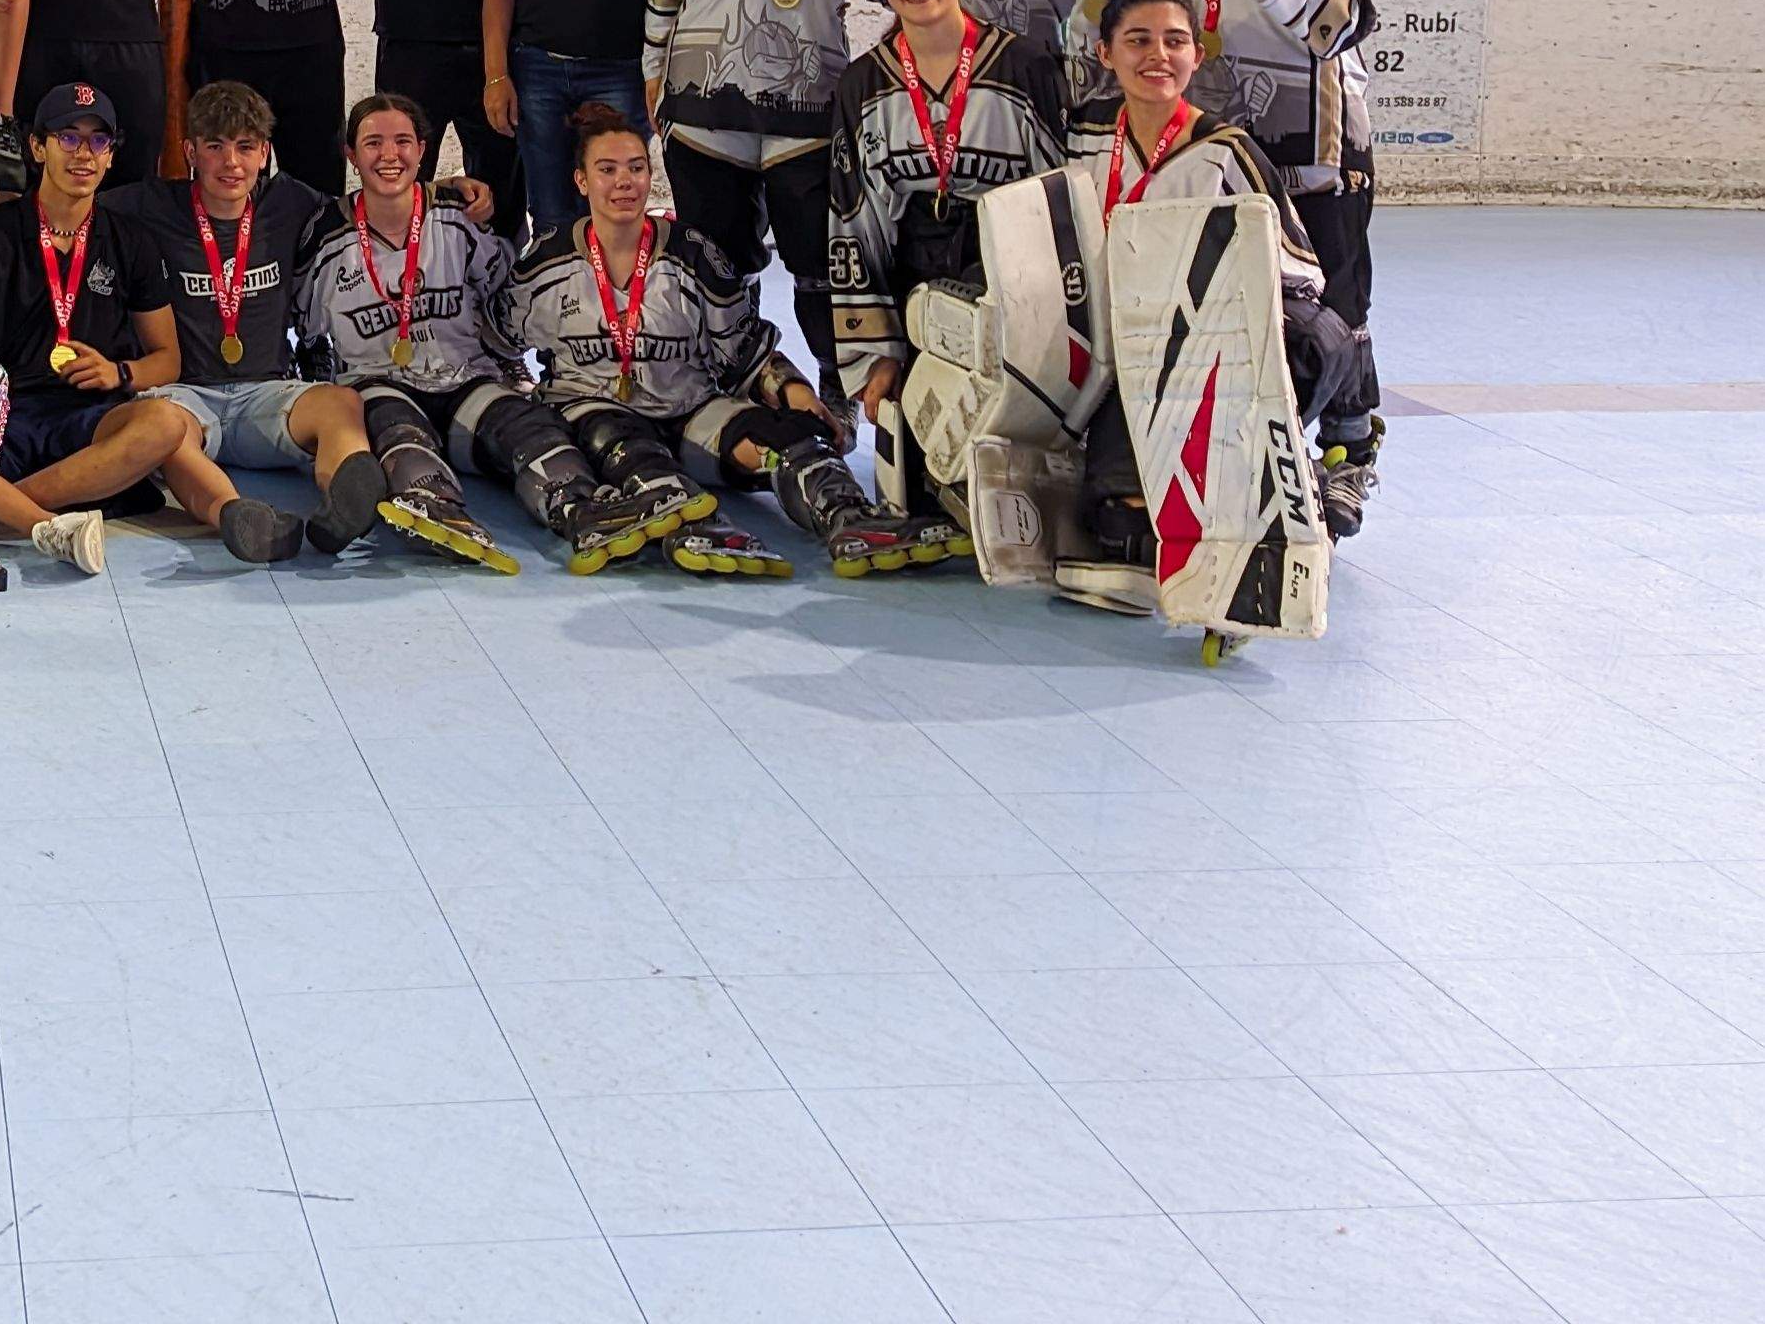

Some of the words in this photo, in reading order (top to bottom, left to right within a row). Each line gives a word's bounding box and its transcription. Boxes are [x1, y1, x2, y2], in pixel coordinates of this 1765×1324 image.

[1405, 12, 1457, 33] Rubí
[1374, 50, 1405, 73] 82
[75, 83, 95, 107] B
[1377, 97, 1391, 108] 93
[1394, 97, 1414, 108] 588
[1417, 97, 1431, 107] 28
[336, 266, 363, 285] Rubi
[338, 277, 366, 293] esport
[1267, 418, 1310, 527] CCM
